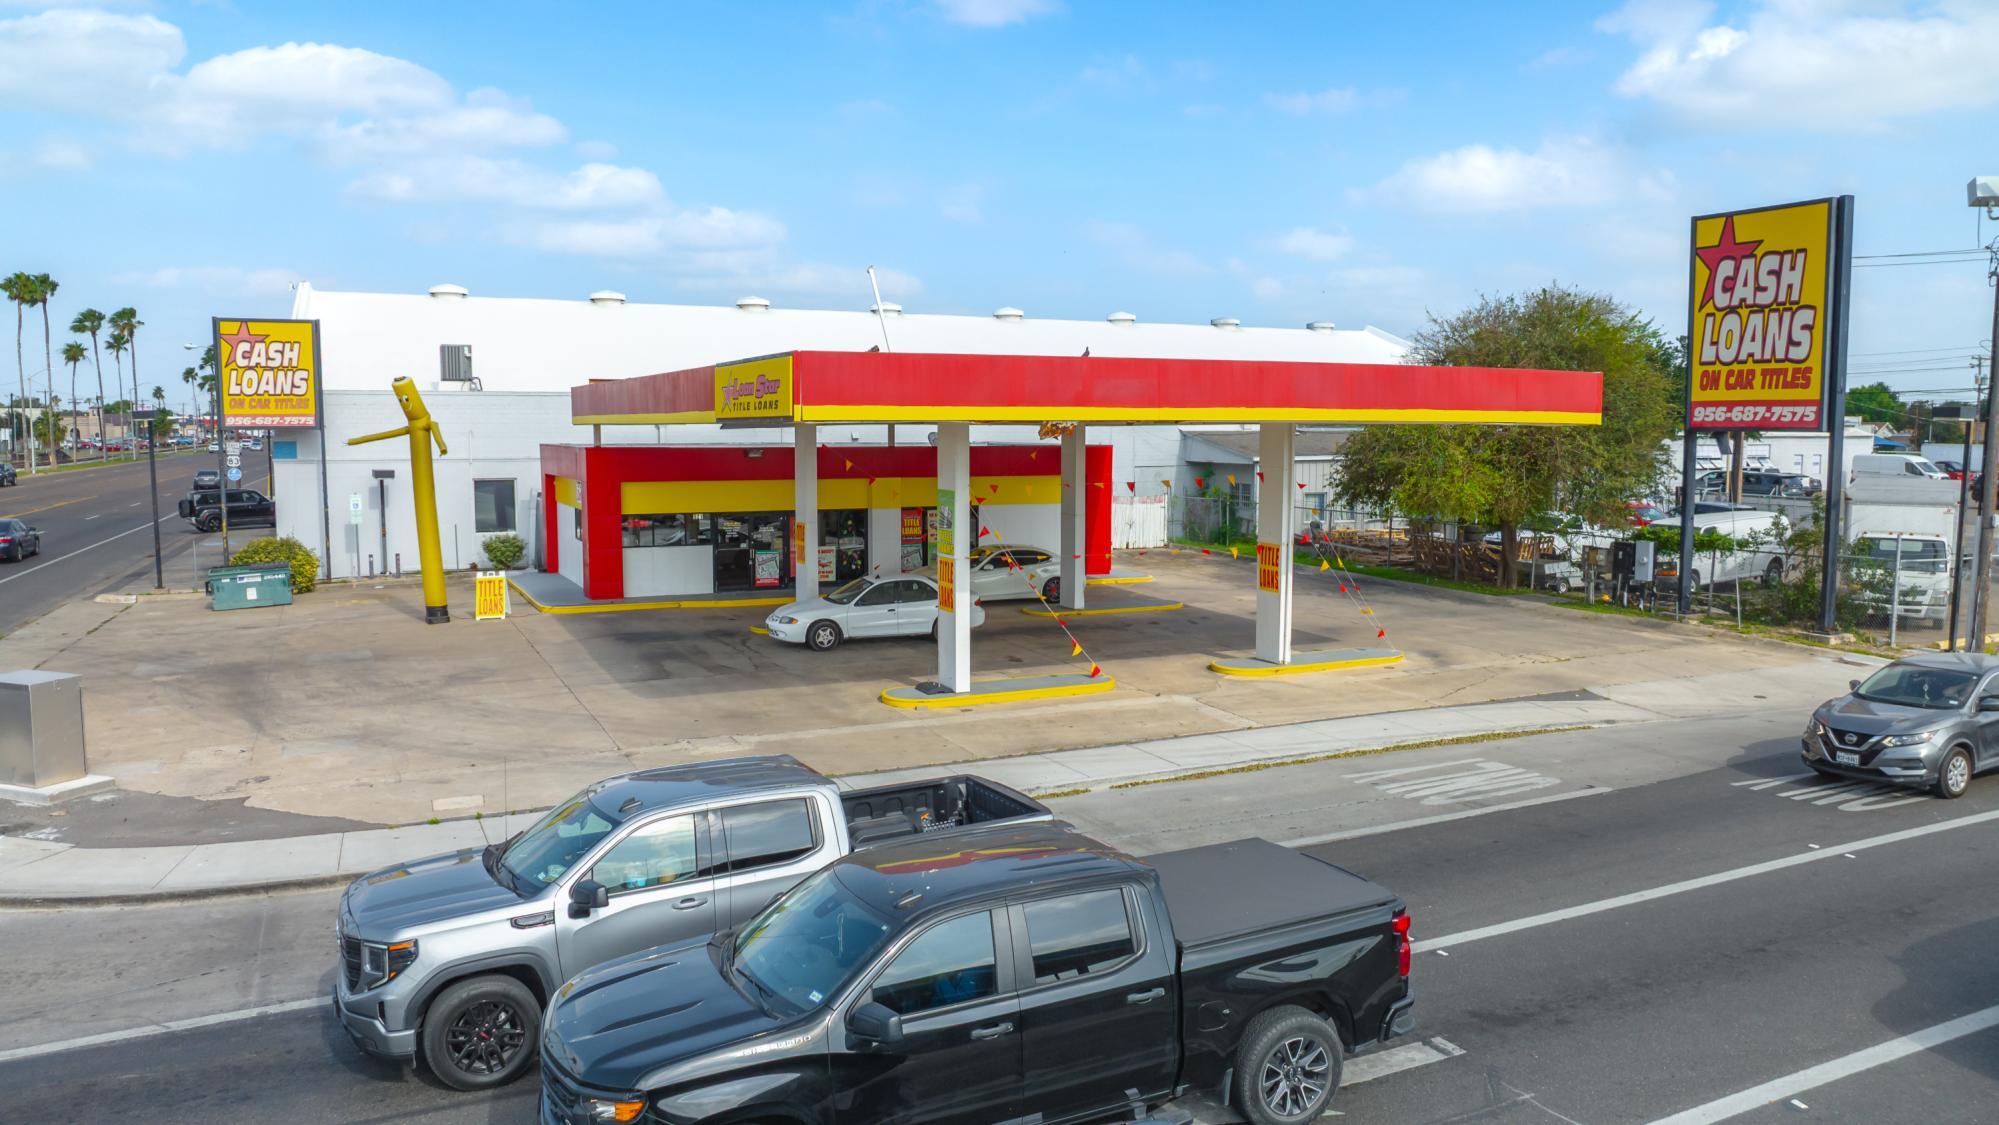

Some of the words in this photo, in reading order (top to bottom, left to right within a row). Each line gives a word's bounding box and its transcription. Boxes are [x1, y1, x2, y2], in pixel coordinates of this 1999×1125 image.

[1713, 249, 1807, 311] CASH
[1699, 305, 1817, 365] LOANS
[235, 340, 301, 368] CASH
[228, 368, 309, 396] LOANS
[755, 374, 781, 398] Star
[1699, 369, 1721, 391] ON
[1725, 368, 1755, 390] CAR
[1761, 366, 1813, 389] TITLES
[229, 398, 245, 409] ON
[248, 398, 270, 409] CAR
[275, 398, 309, 409] TITLES
[732, 401, 751, 412] TITLE
[753, 400, 779, 410] LOANS
[1693, 406, 1817, 422] 956-687-7575
[225, 416, 314, 425] 956-687-7575
[228, 457, 239, 465] 83
[902, 527, 922, 536] LOANS
[904, 518, 920, 527] TITLE
[1261, 545, 1279, 567] TITLE
[940, 559, 954, 584] TITLE
[1259, 568, 1278, 590] LOANS
[479, 580, 503, 597] TITLE
[939, 584, 954, 609] LOANS
[479, 597, 504, 614] LOANS
